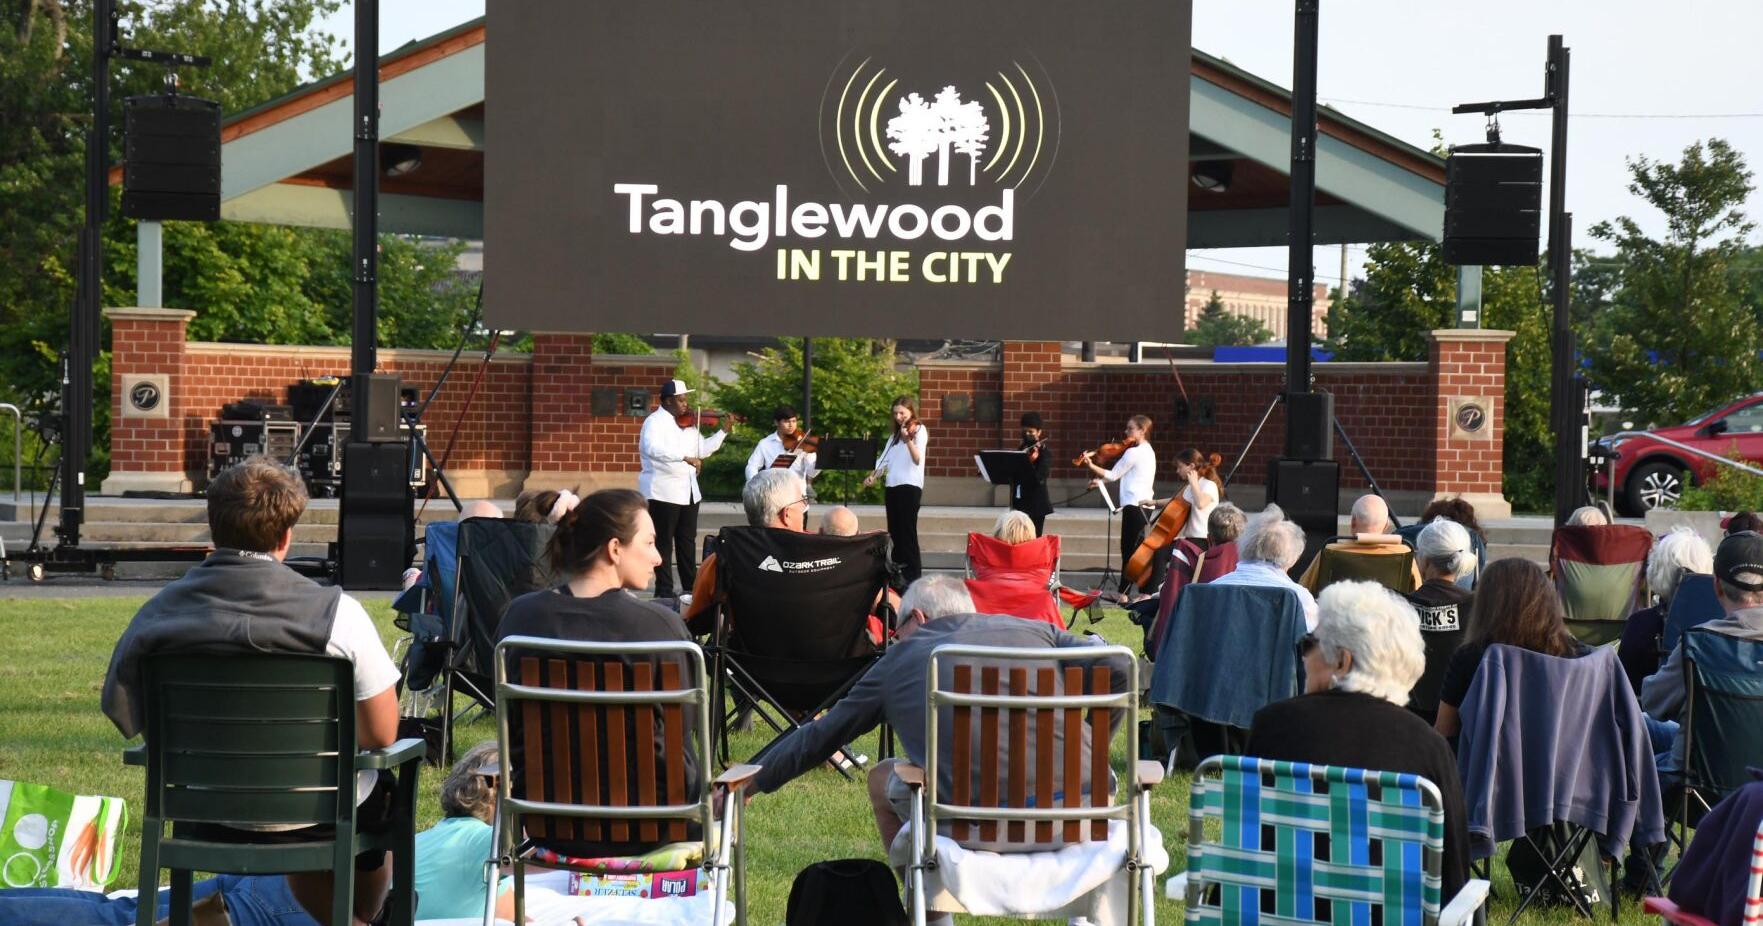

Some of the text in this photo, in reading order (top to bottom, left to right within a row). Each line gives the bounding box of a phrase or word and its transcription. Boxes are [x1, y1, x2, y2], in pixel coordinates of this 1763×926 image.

[614, 183, 1014, 252] Tanglewood
[776, 249, 1012, 284] IN THE CITY
[661, 878, 687, 894] POLAR
